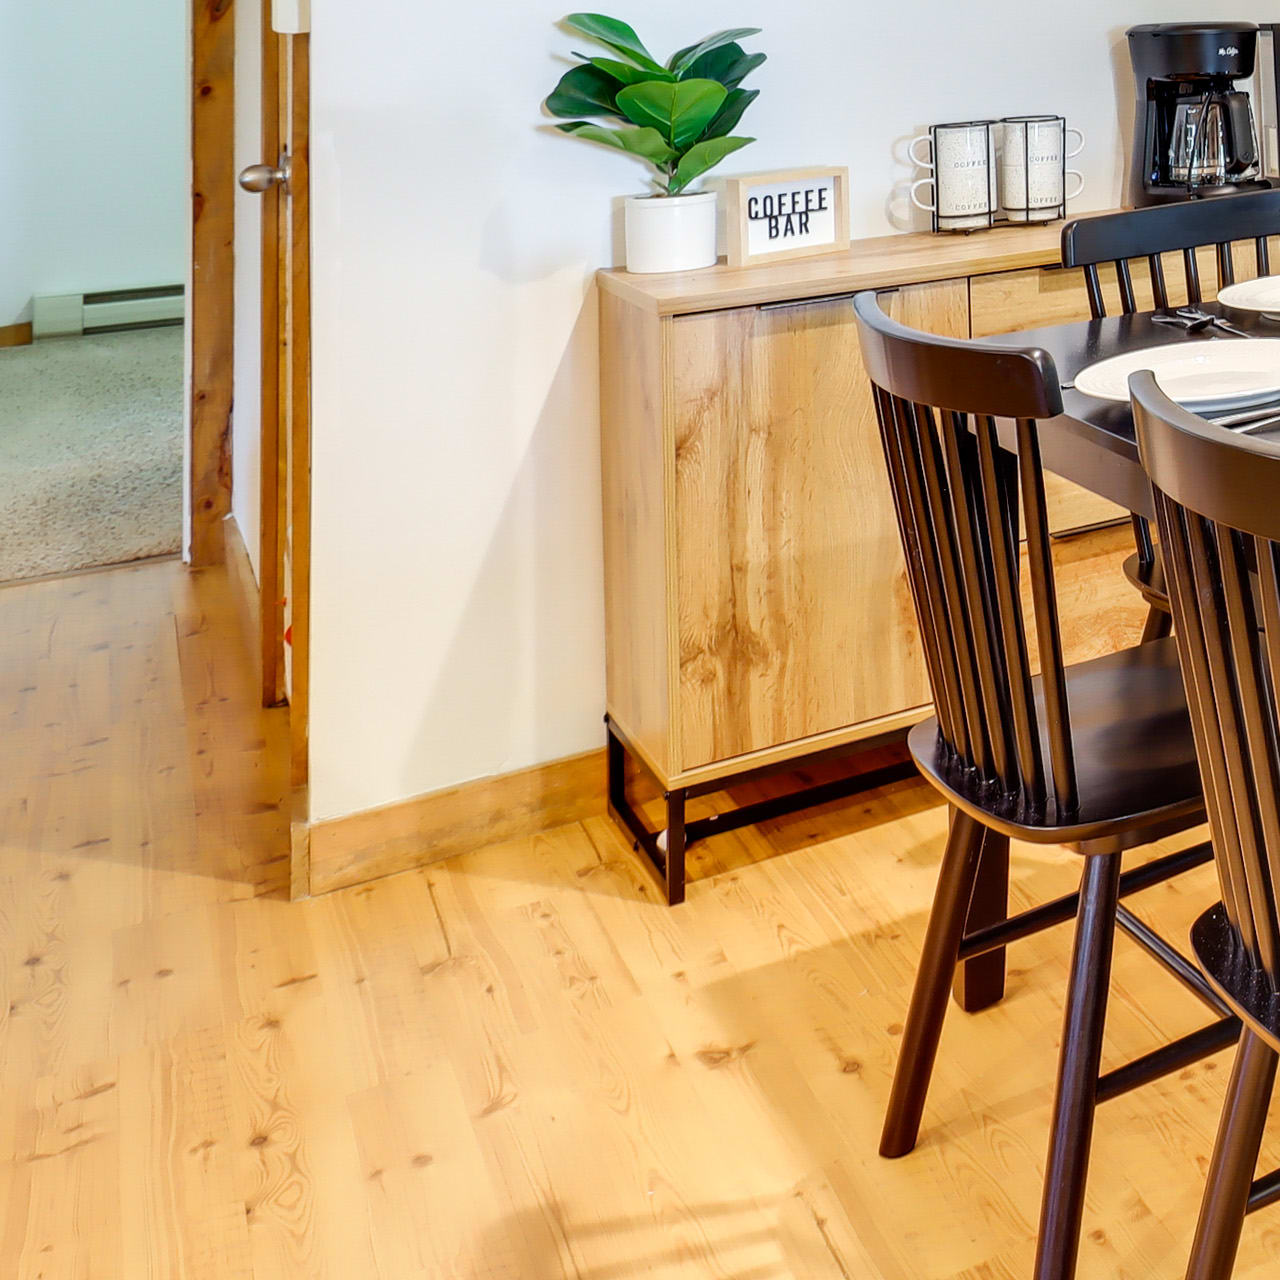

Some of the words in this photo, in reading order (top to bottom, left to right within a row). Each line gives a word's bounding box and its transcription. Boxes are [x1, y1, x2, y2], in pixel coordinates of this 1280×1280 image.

[954, 160, 987, 168] COFFEE
[747, 187, 829, 220] COFFEE
[955, 202, 987, 210] COFFEE
[768, 211, 810, 240] BAR
